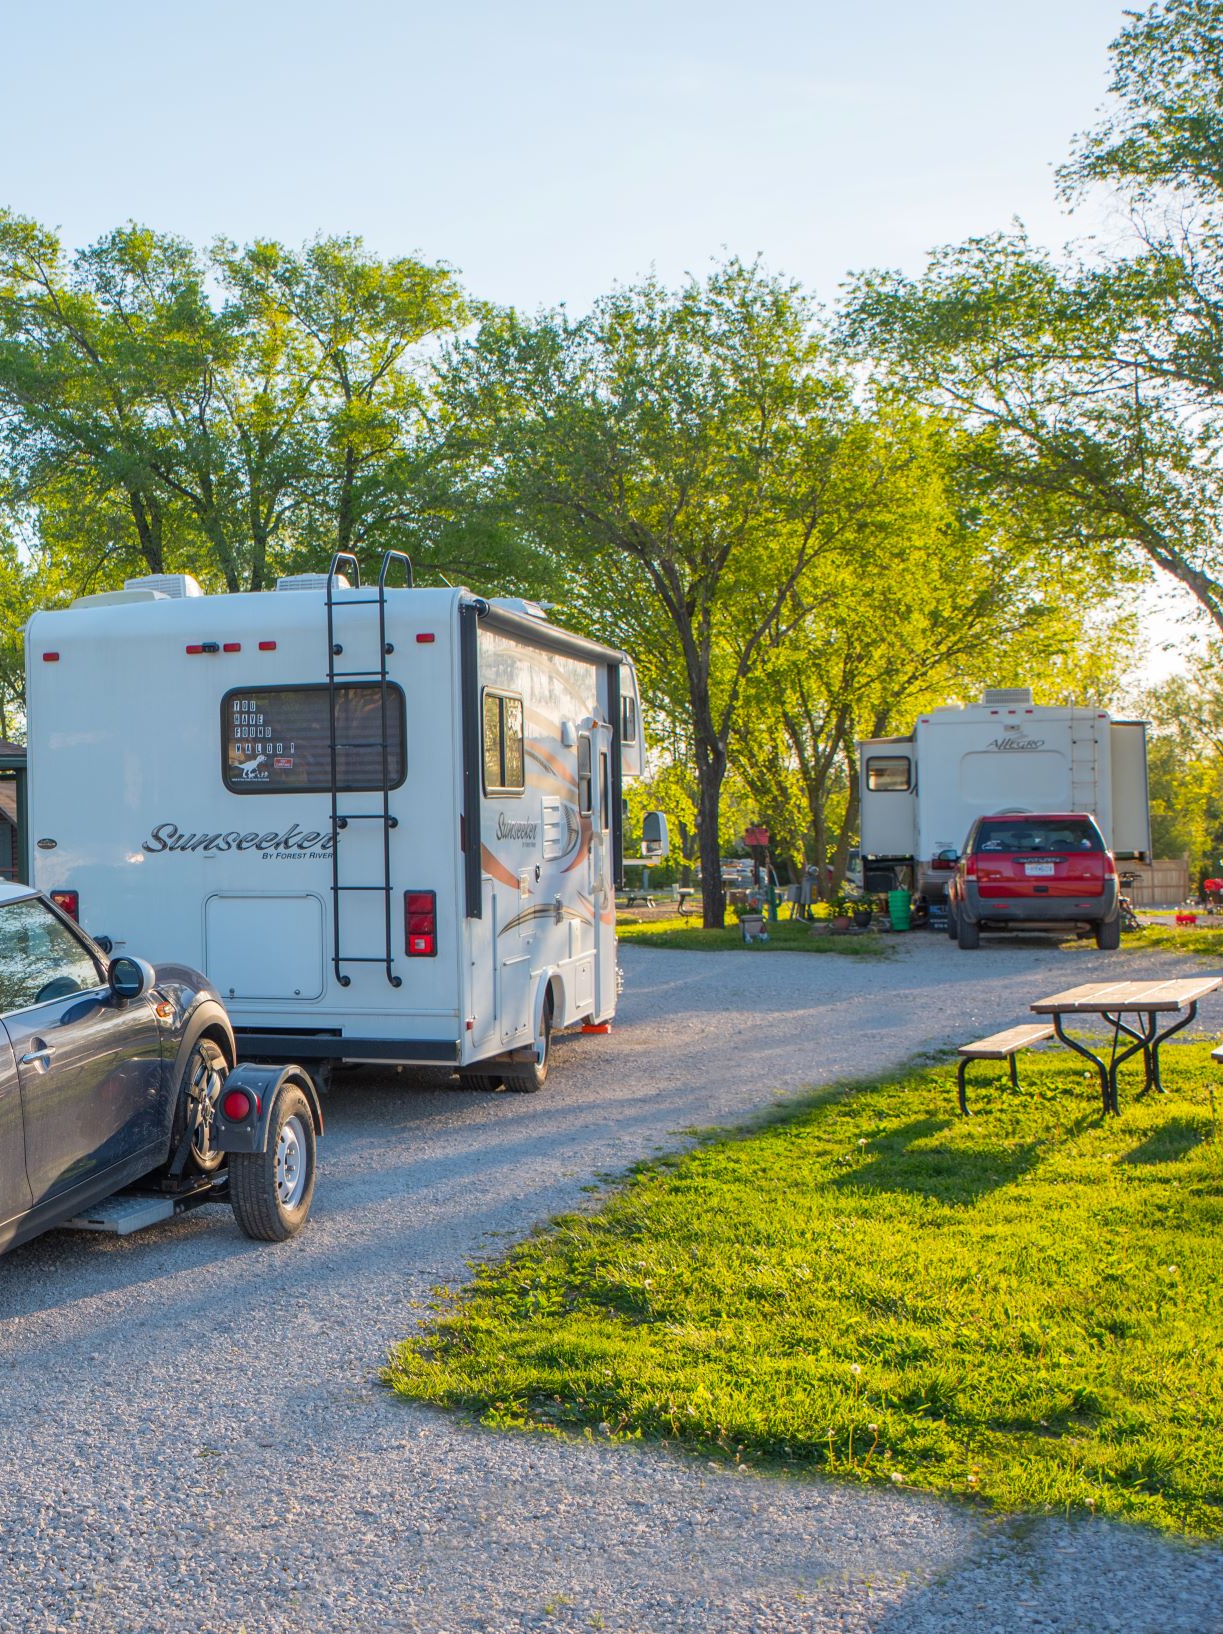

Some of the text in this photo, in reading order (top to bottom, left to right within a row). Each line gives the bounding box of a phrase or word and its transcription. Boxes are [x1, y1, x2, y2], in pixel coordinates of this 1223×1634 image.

[234, 701, 255, 711] YOU
[234, 714, 263, 724] HAVE
[235, 727, 271, 737] FOUND
[496, 812, 537, 840] Sunseeker
[142, 823, 341, 853] Sunseeker
[276, 852, 308, 860] FOREST
[309, 851, 334, 859] RIVER
